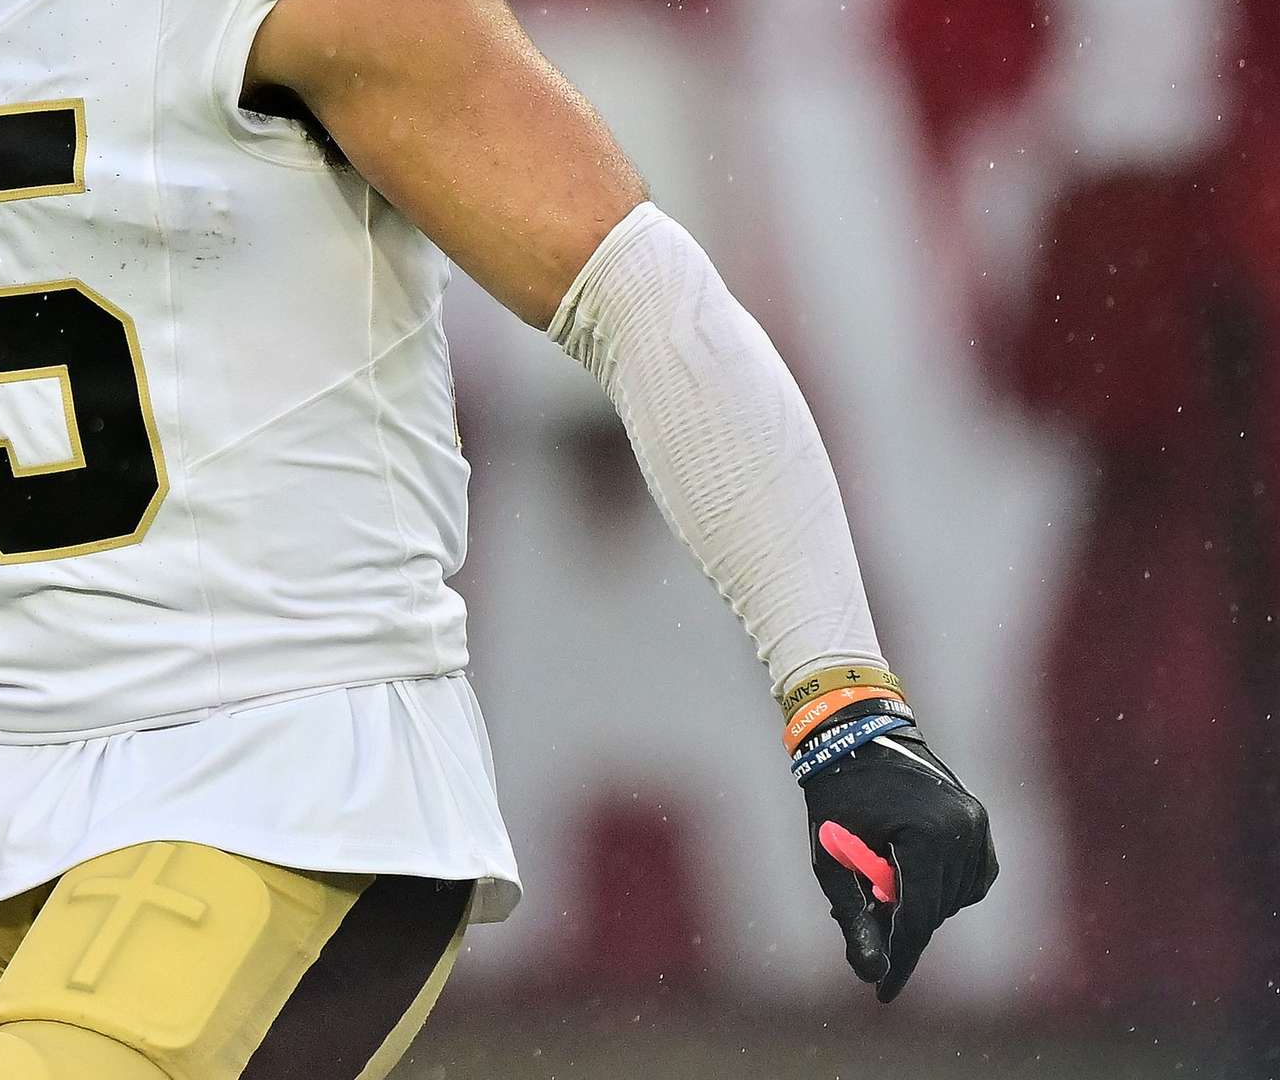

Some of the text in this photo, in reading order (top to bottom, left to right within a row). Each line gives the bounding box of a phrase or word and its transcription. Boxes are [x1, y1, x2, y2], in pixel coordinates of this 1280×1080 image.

[791, 701, 828, 736] SAINTS
[830, 733, 856, 752] ALL
[815, 748, 832, 764] IN
